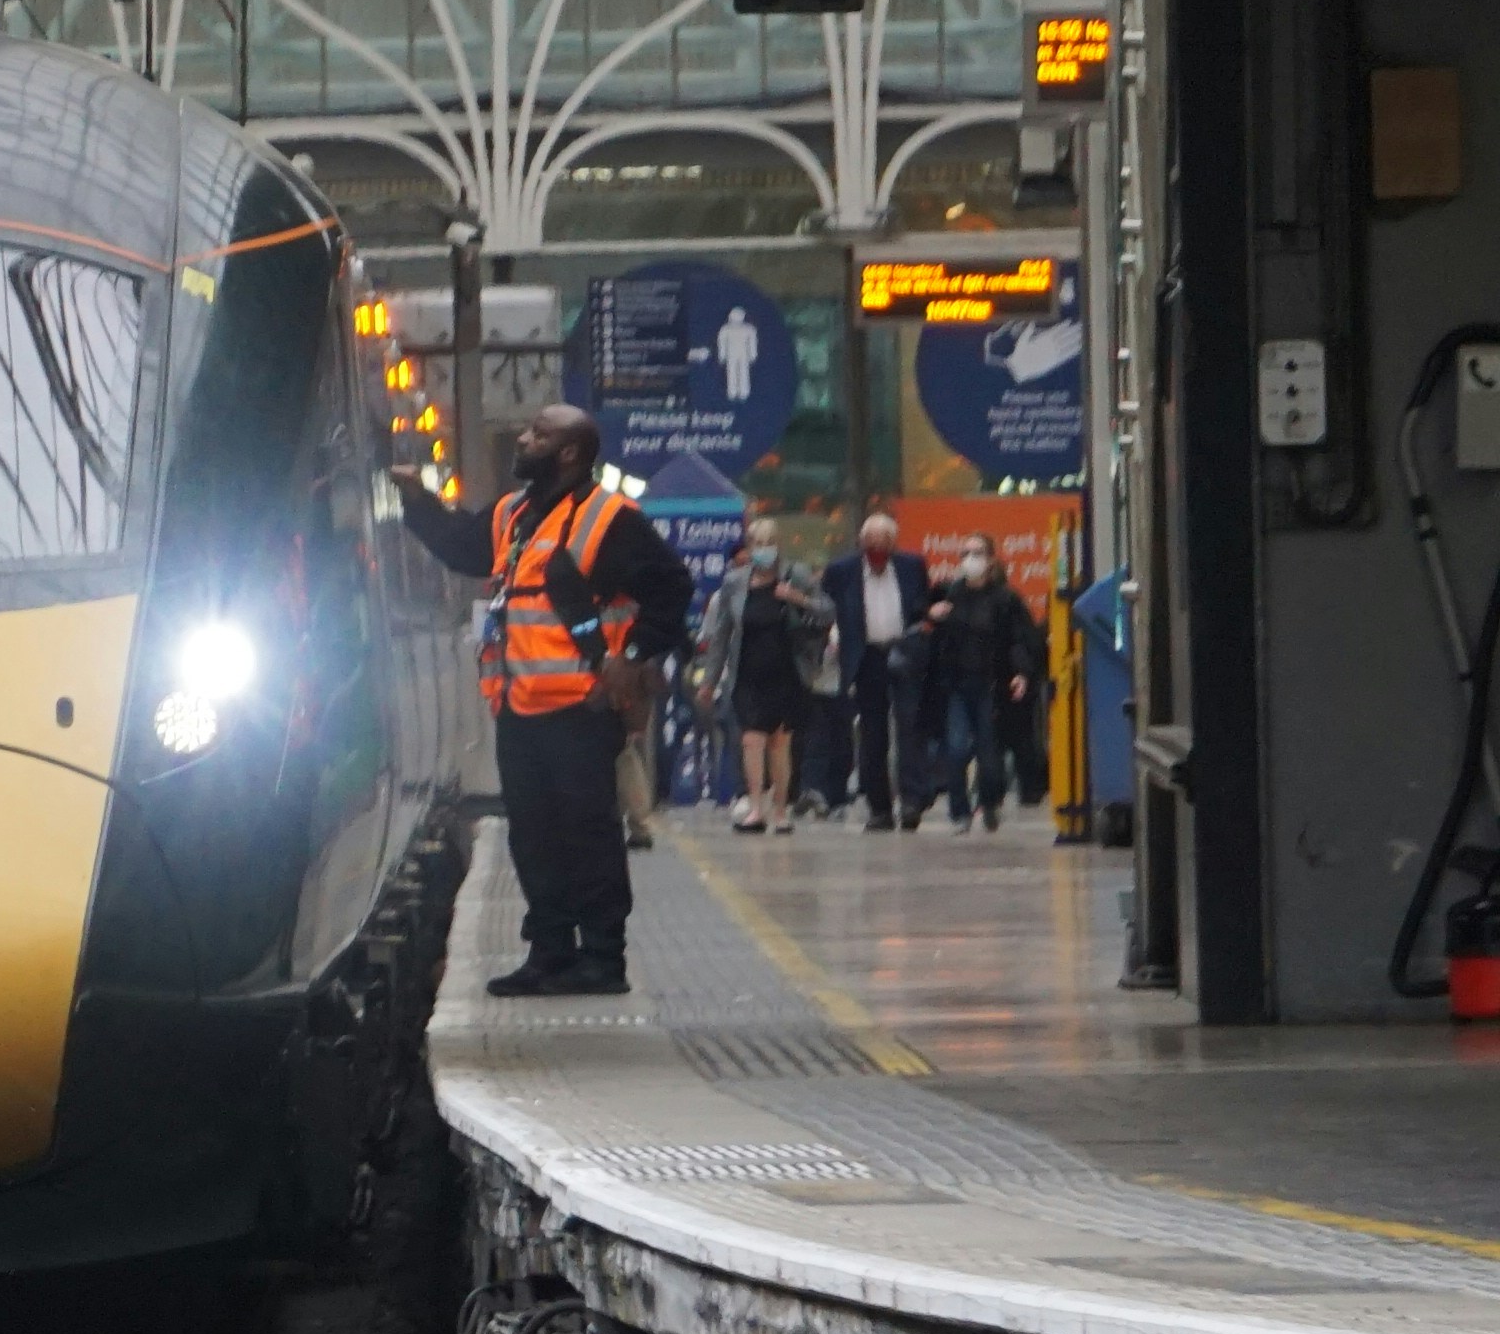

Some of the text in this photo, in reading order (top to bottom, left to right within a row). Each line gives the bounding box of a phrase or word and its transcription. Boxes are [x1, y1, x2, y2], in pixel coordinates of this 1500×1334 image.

[628, 409, 735, 431] Please keep
[622, 431, 742, 458] your distance
[676, 517, 743, 541] Toilets
